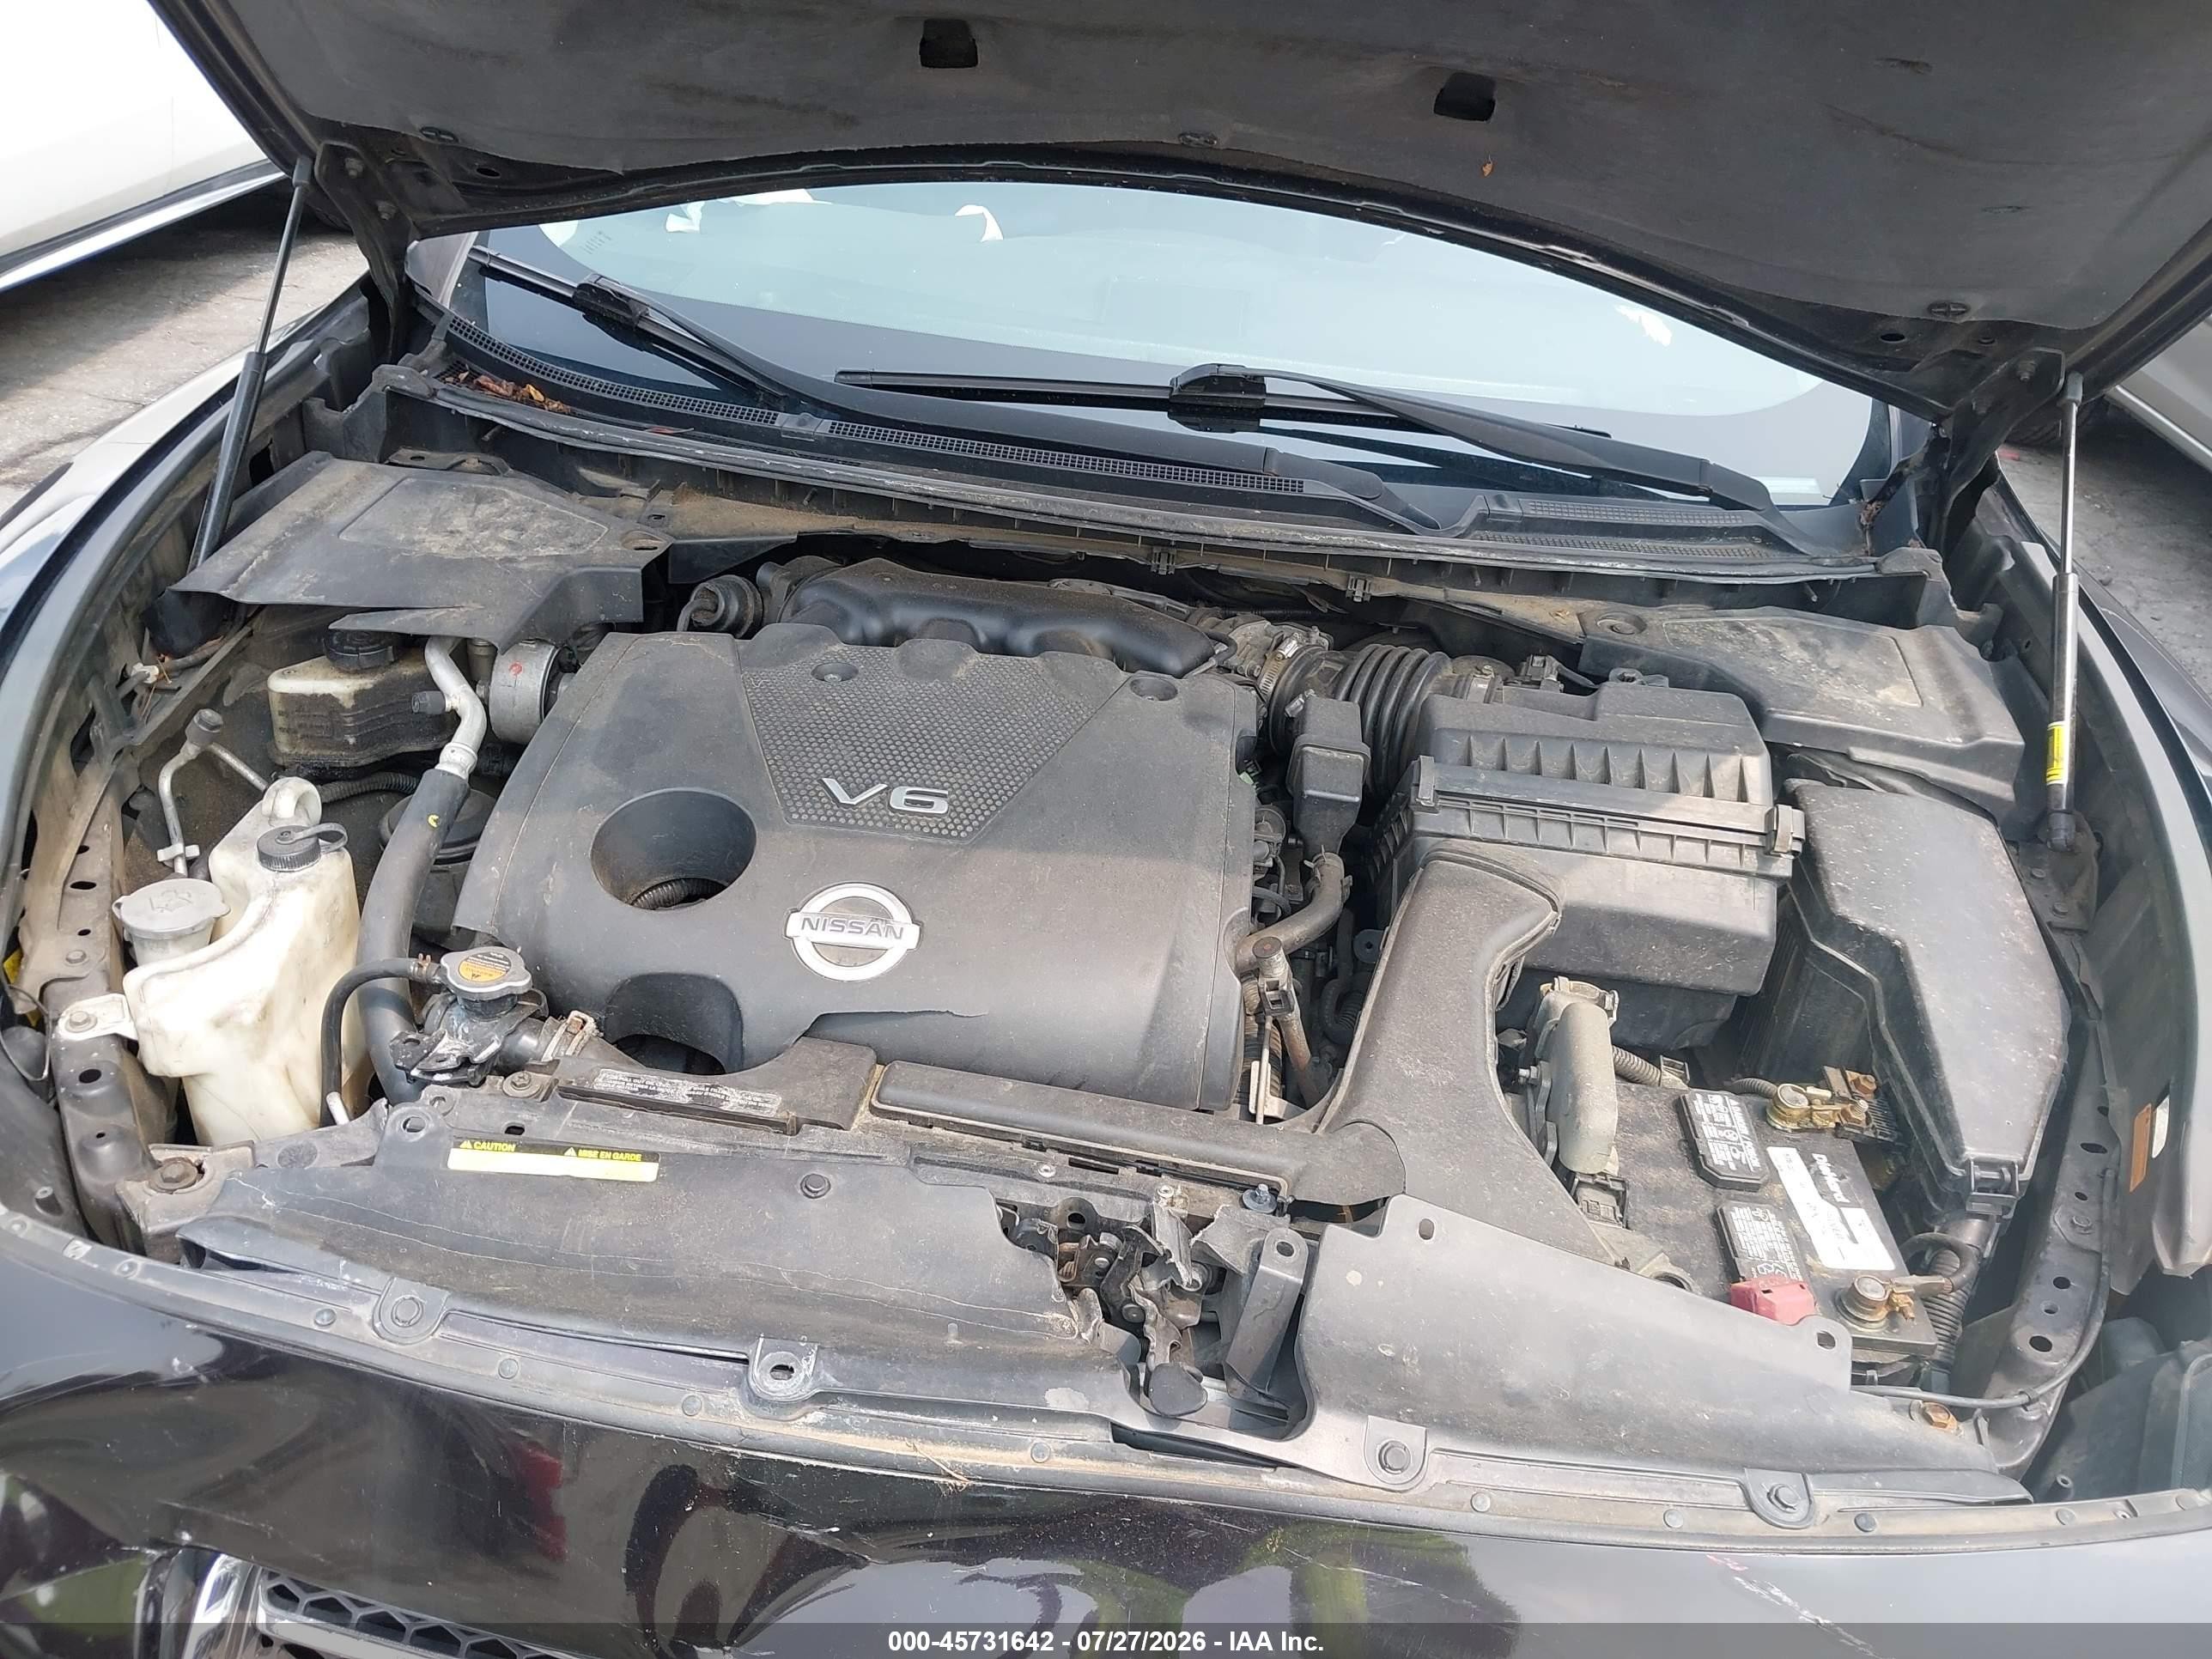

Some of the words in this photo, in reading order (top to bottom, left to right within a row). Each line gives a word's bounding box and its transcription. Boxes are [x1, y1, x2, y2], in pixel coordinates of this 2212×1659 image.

[819, 777, 949, 815] V6
[800, 916, 905, 940] NISSAN
[473, 1140, 516, 1152] CAUTION
[577, 1148, 599, 1158] MISE
[599, 1150, 612, 1159] EN
[612, 1152, 642, 1162] GARDE
[1811, 1152, 1851, 1203] DieHard
